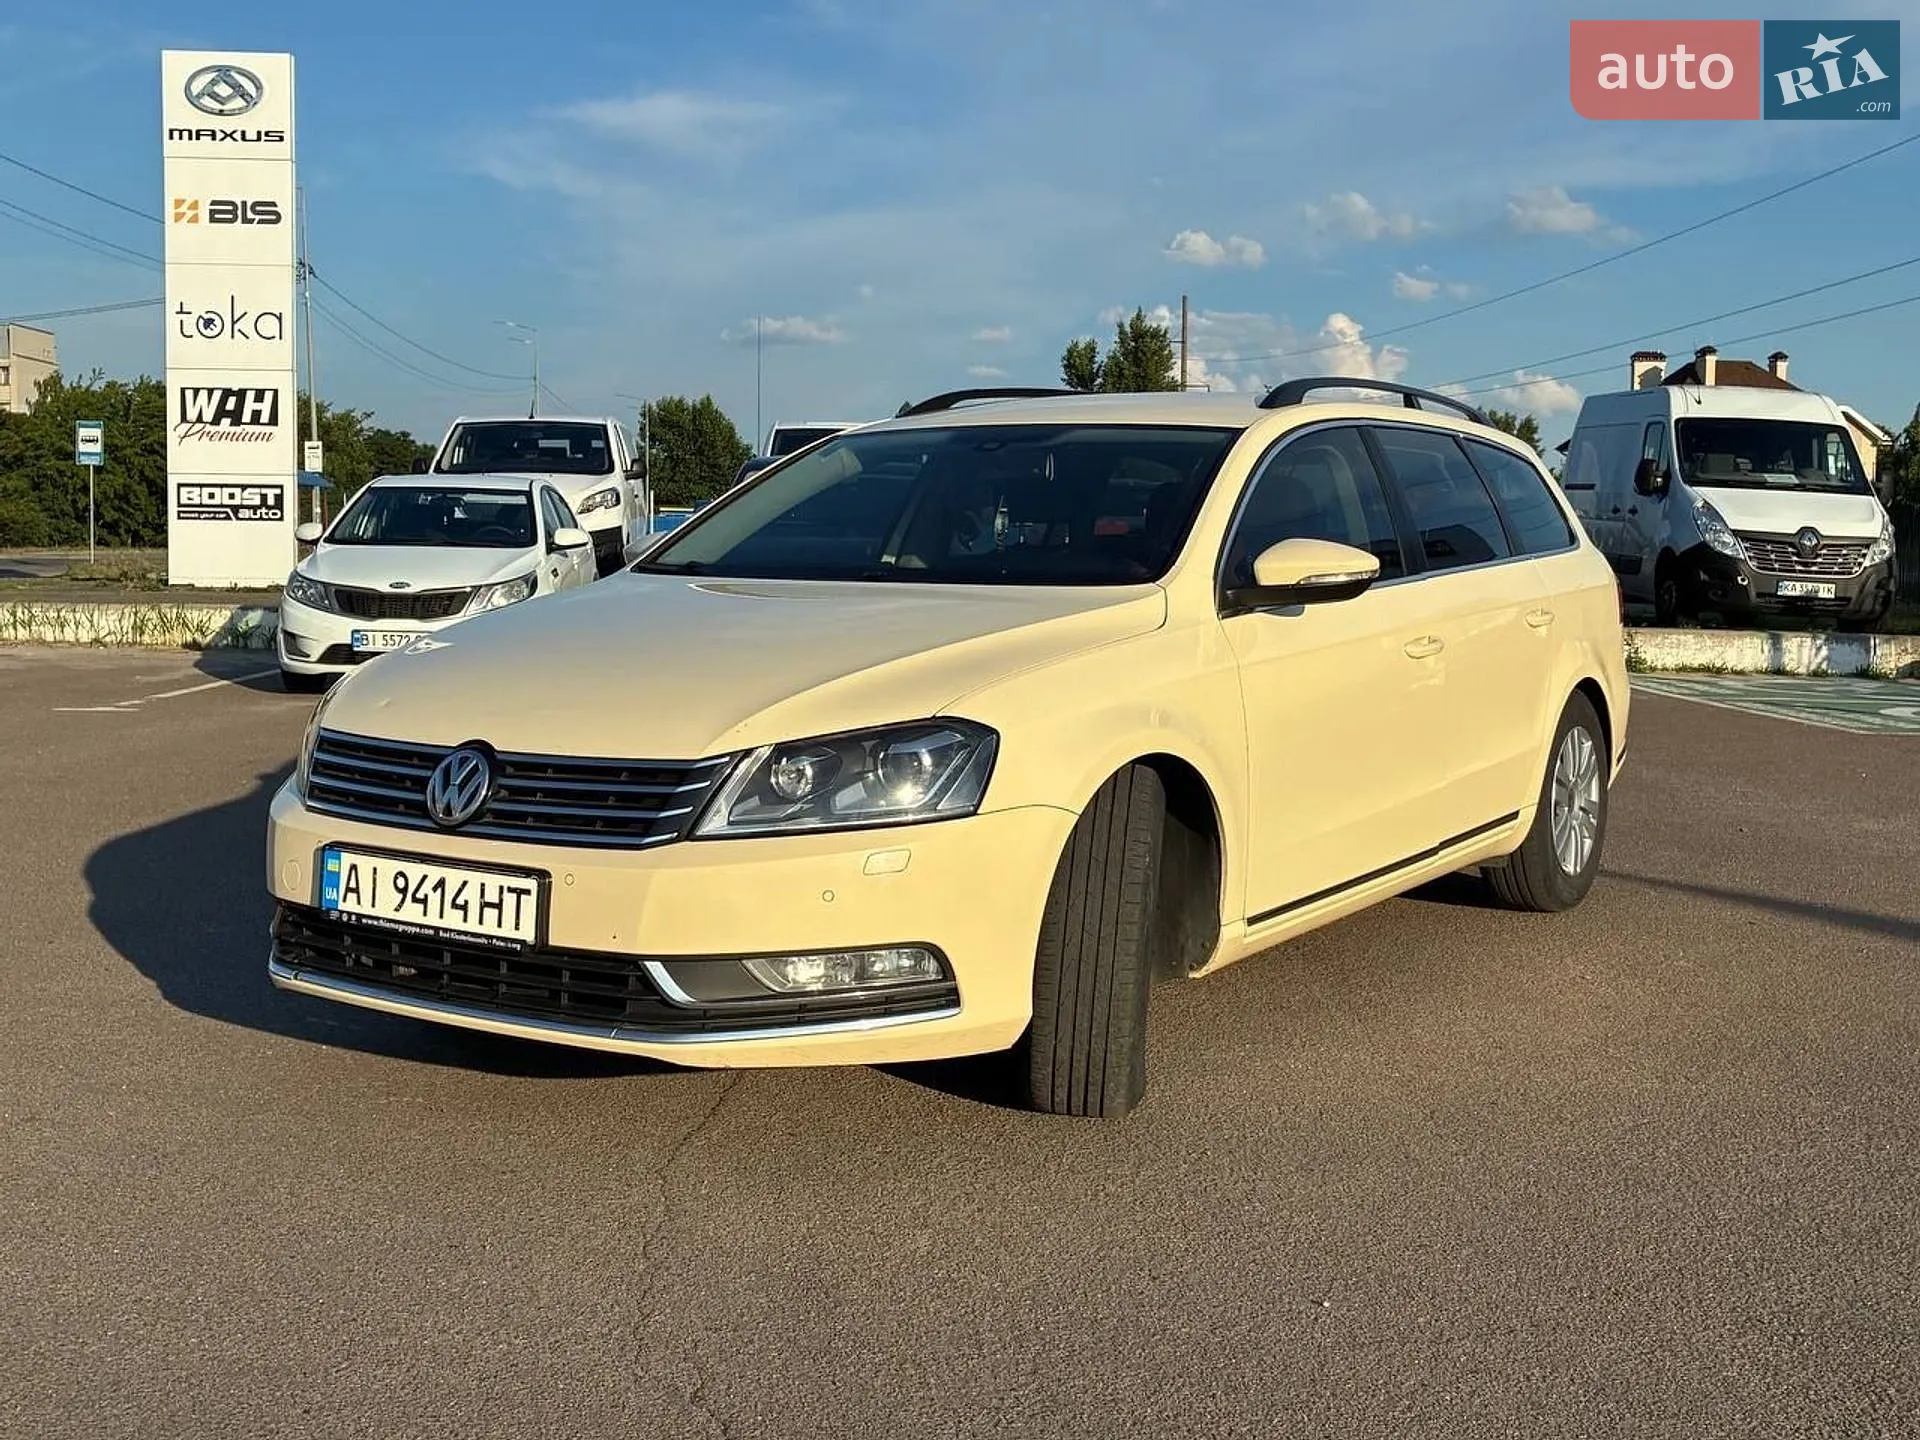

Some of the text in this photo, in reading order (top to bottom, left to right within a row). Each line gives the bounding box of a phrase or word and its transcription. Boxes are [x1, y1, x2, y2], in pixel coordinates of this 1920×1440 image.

[168, 127, 285, 142] MAXUS
[208, 199, 282, 225] BLS
[175, 294, 283, 341] toka
[173, 422, 275, 447] Premium
[179, 487, 282, 506] BOOST
[238, 506, 282, 519] auto
[325, 886, 338, 900] UA
[342, 862, 532, 931] AI 9414 HT
